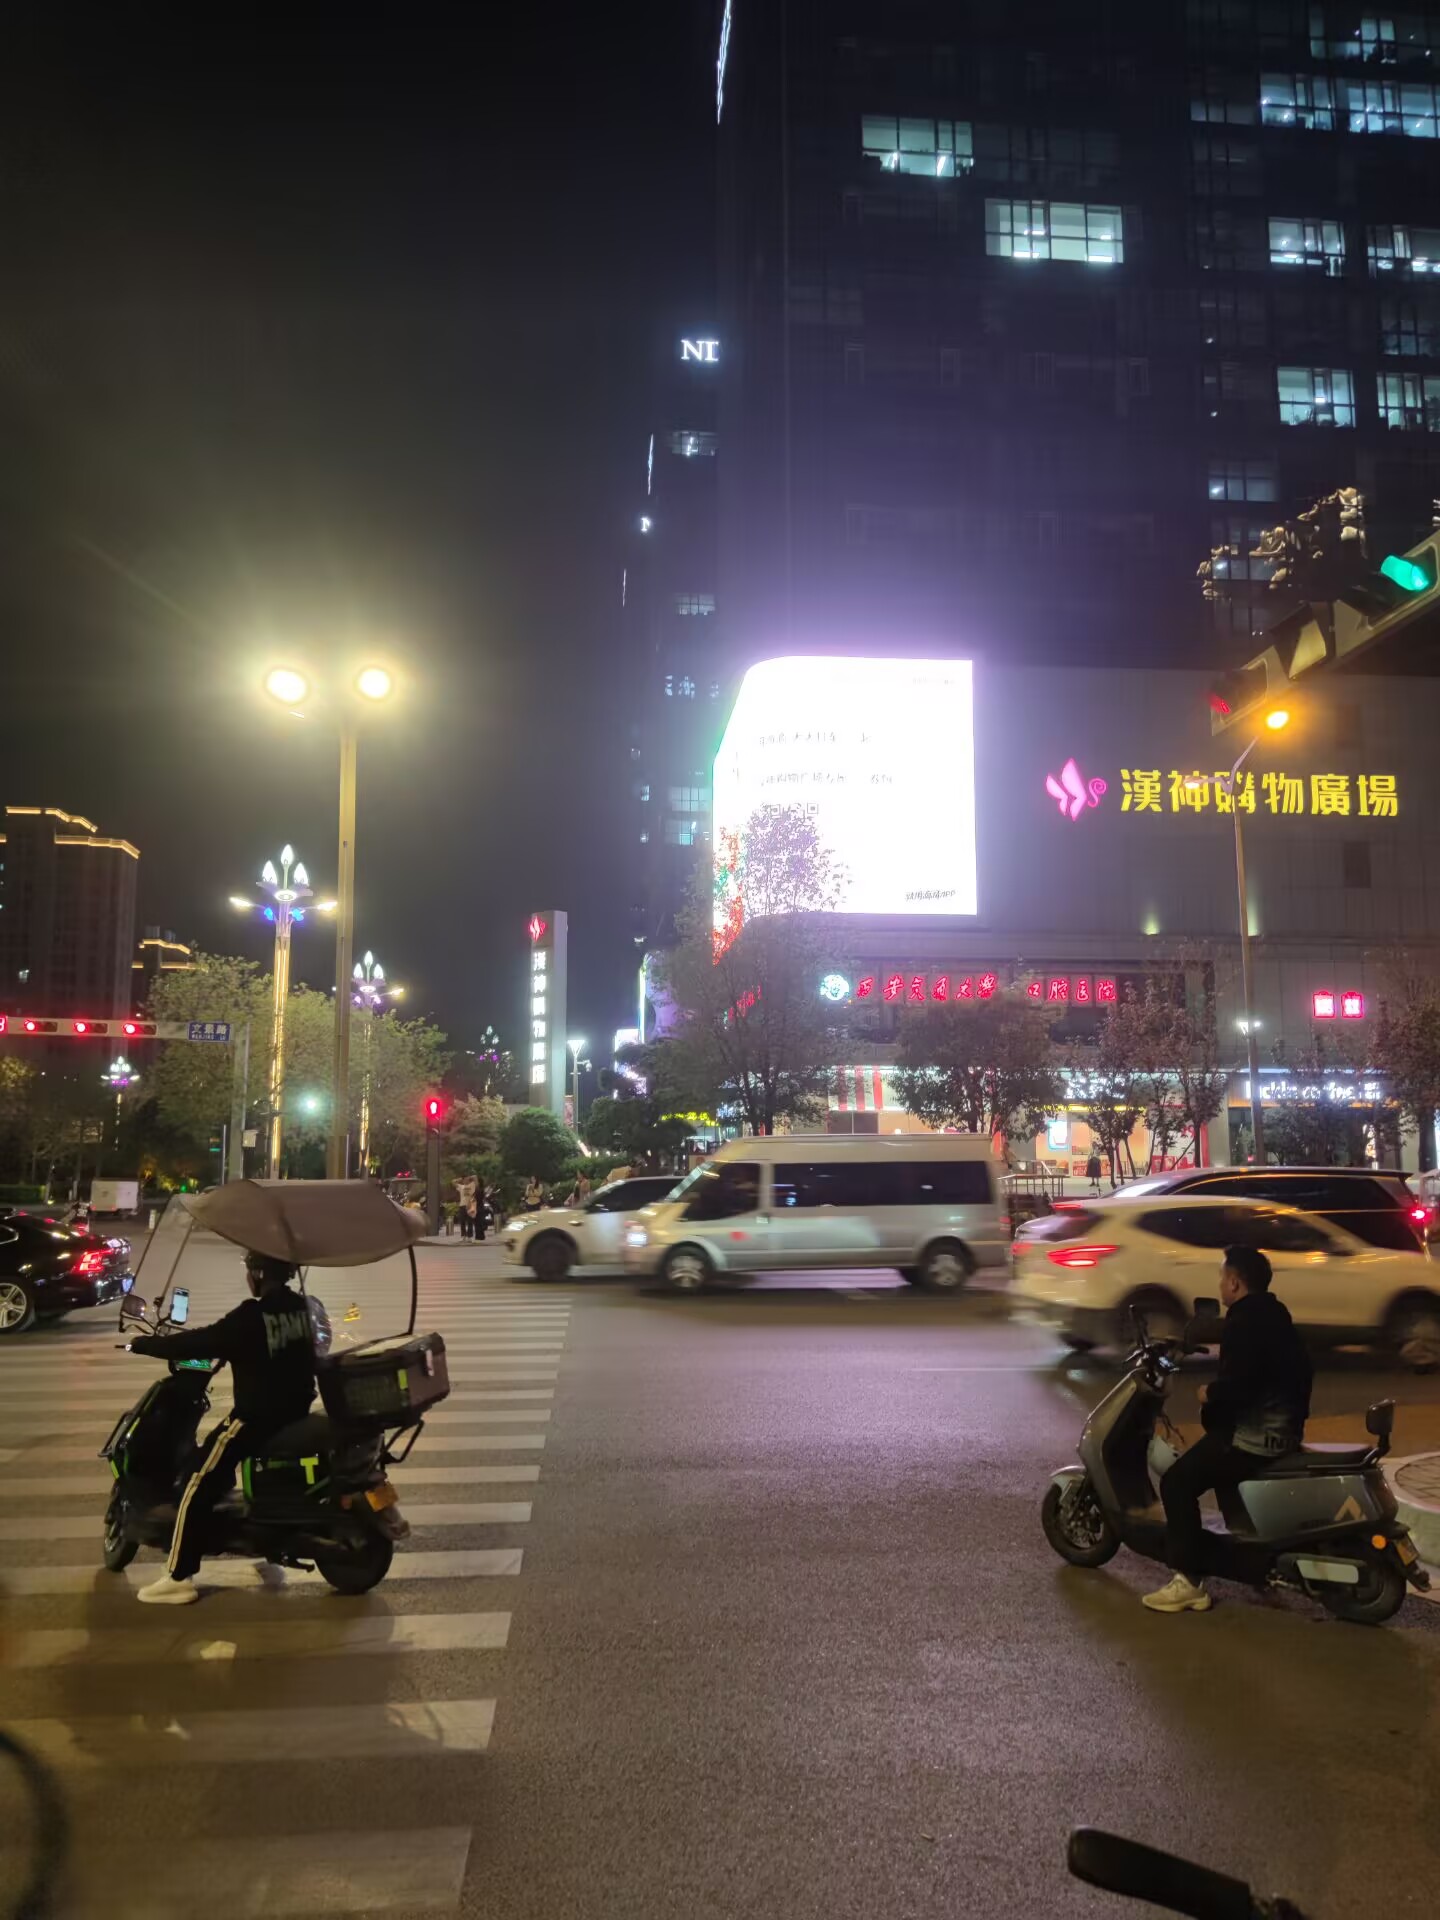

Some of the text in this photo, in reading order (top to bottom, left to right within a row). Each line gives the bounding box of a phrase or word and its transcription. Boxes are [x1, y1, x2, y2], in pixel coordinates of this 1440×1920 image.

[1120, 768, 1398, 816] 漢神購物廣場
